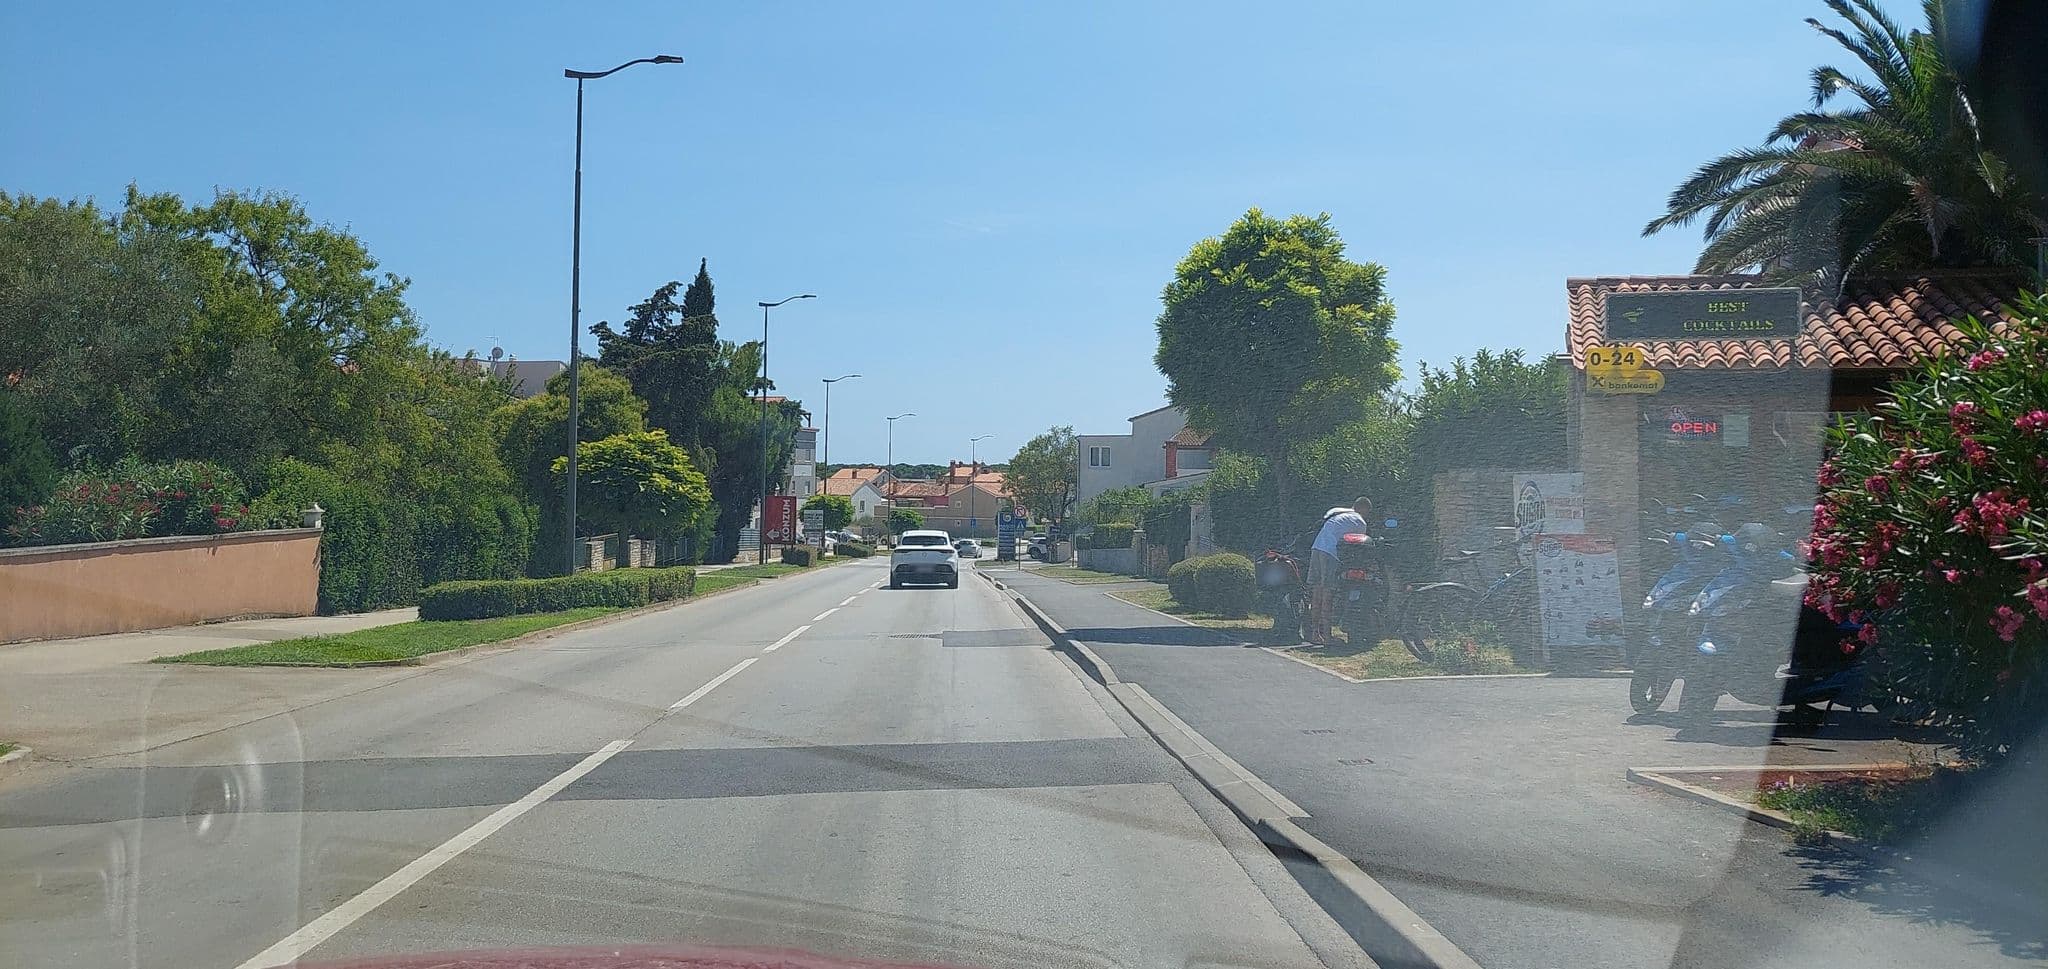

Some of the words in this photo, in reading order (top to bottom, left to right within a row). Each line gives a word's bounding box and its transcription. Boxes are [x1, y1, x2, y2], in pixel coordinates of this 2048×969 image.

[1707, 301, 1749, 313] BEST
[1683, 319, 1775, 332] COCKTAILS
[1590, 351, 1636, 366] 0-24
[1608, 380, 1658, 390] bankomat
[1671, 422, 1717, 433] OPEN
[782, 499, 791, 542] KONZUM
